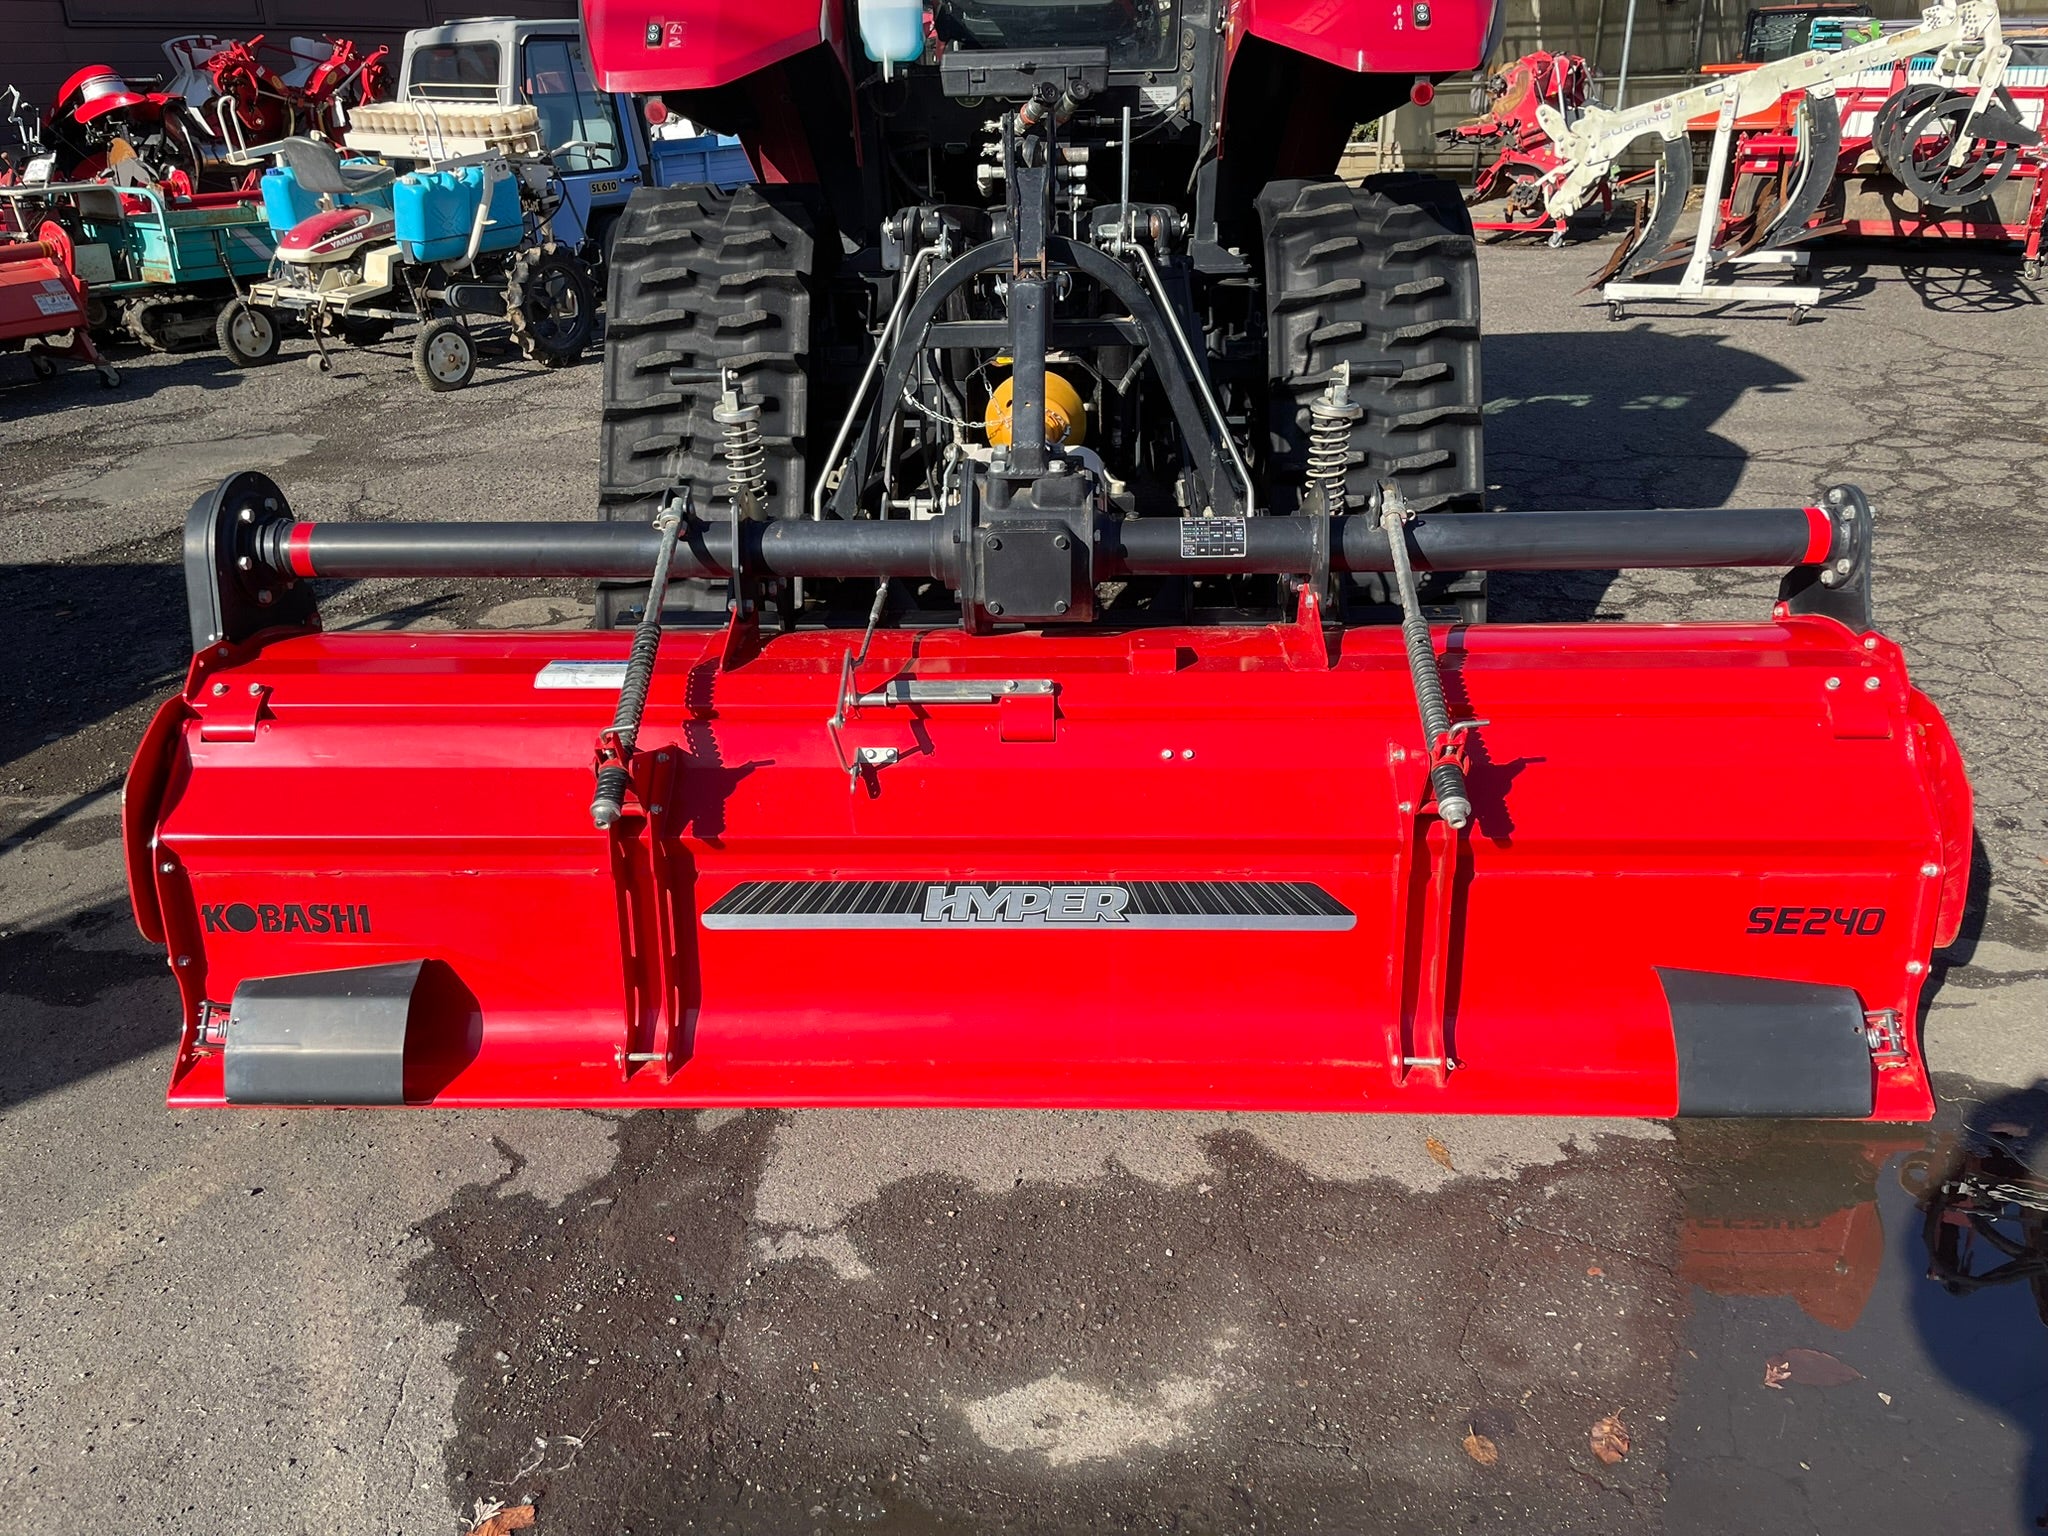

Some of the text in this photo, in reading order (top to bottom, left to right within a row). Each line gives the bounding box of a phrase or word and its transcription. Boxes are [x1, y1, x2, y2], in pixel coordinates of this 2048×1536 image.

[1600, 111, 1672, 139] SUGANO
[591, 181, 617, 193] SL610
[330, 232, 364, 249] YANMAR
[921, 885, 1129, 922] HYPER
[201, 903, 372, 933] KOBASHI
[1746, 907, 1887, 936] SE240
